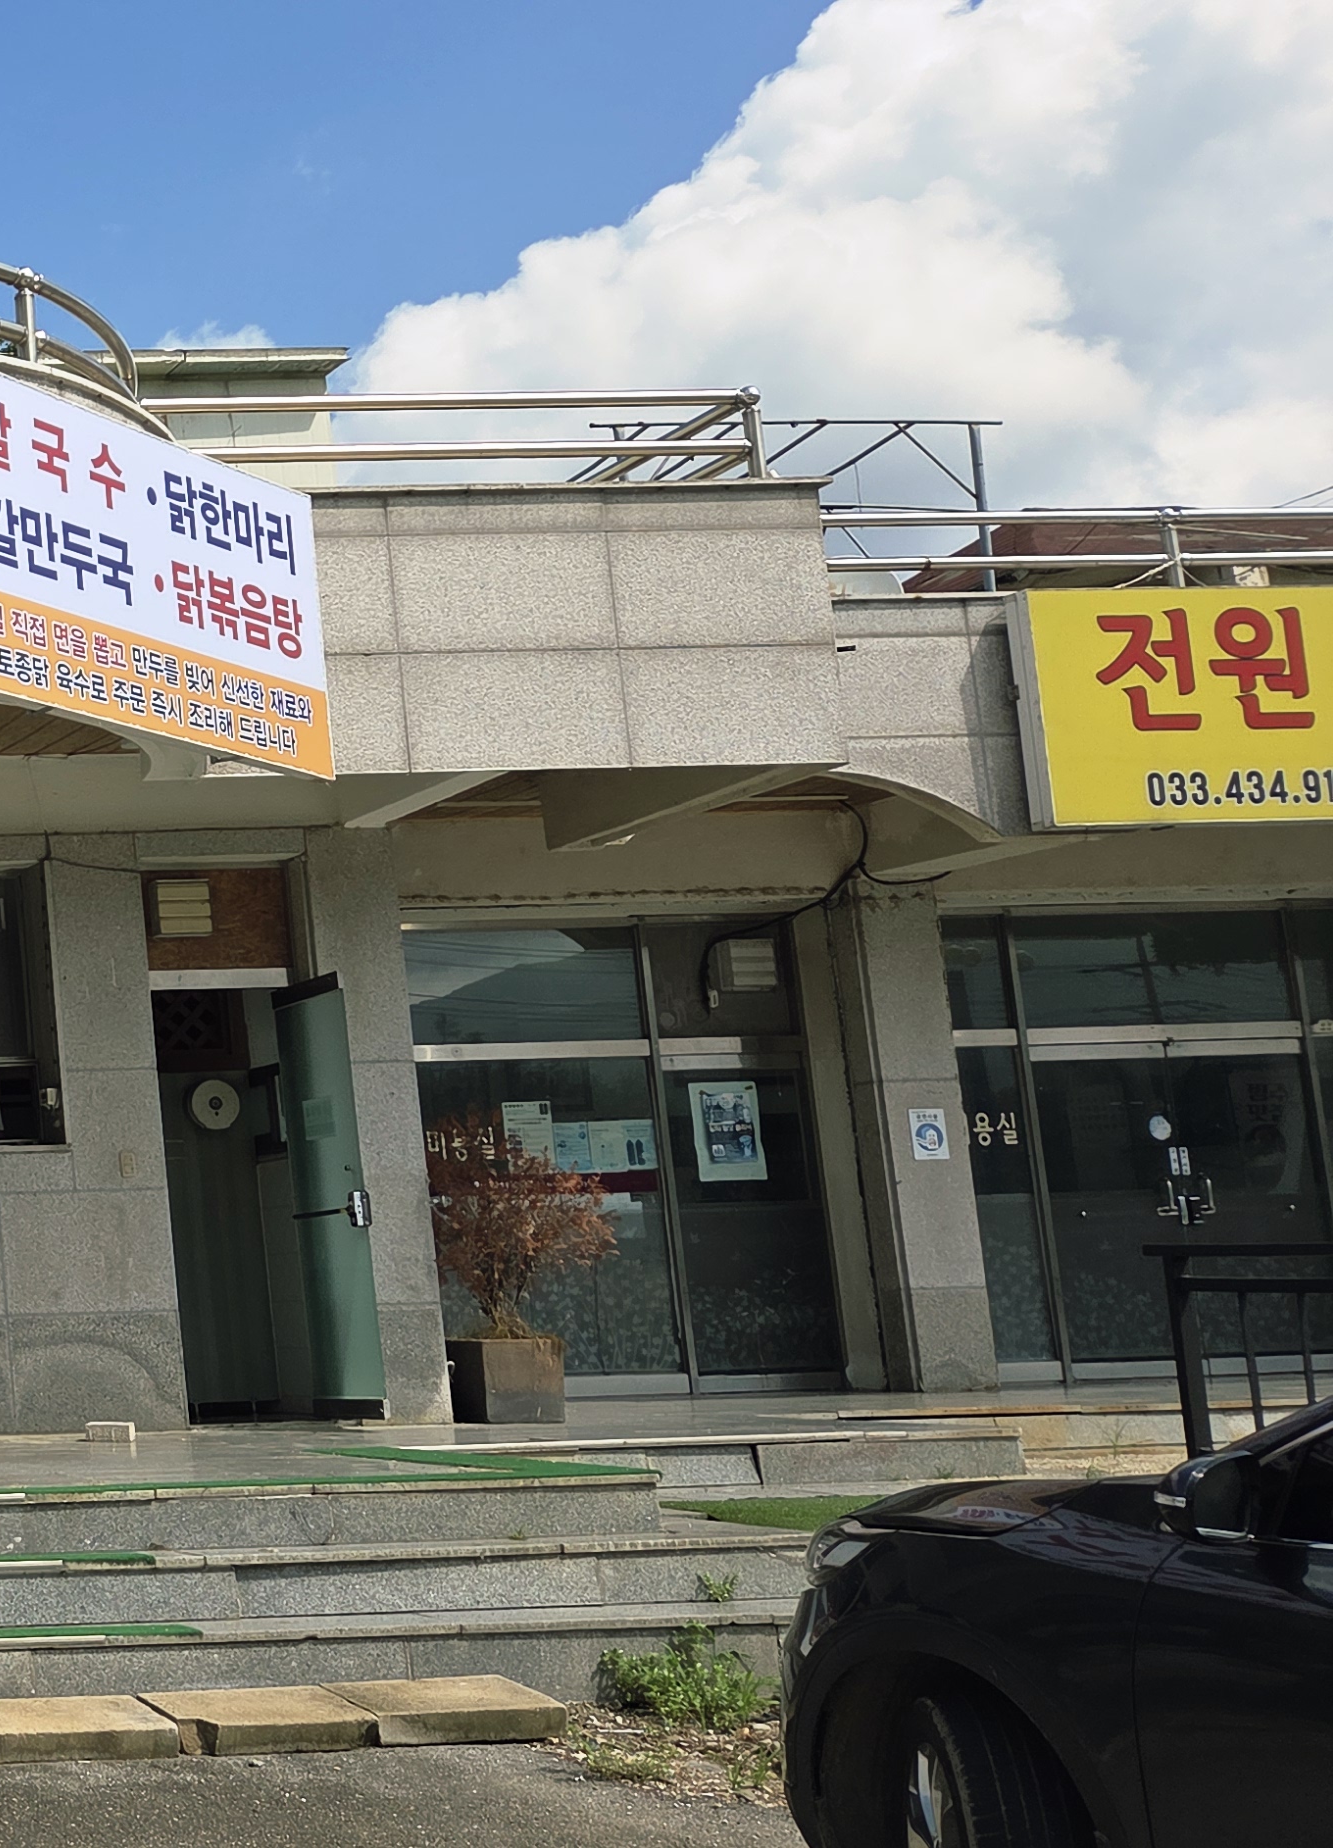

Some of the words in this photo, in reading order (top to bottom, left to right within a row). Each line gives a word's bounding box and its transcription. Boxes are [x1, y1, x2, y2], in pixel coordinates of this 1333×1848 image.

[163, 470, 297, 576] 닭한마리
[171, 560, 303, 659] 닭볶음탕
[11, 609, 48, 649] 직접
[52, 622, 87, 660] 면을
[93, 633, 128, 668] 뽑고
[132, 646, 179, 686] 만두를
[184, 662, 216, 697] 빚어
[221, 674, 265, 711] 신선한
[269, 688, 312, 725] 재료와
[55, 663, 108, 702] 육수로
[112, 678, 146, 714] 주문
[151, 690, 183, 725] 즉시
[188, 701, 234, 739] 조리해
[238, 715, 296, 756] 드립니다
[1096, 606, 1316, 732] 전원
